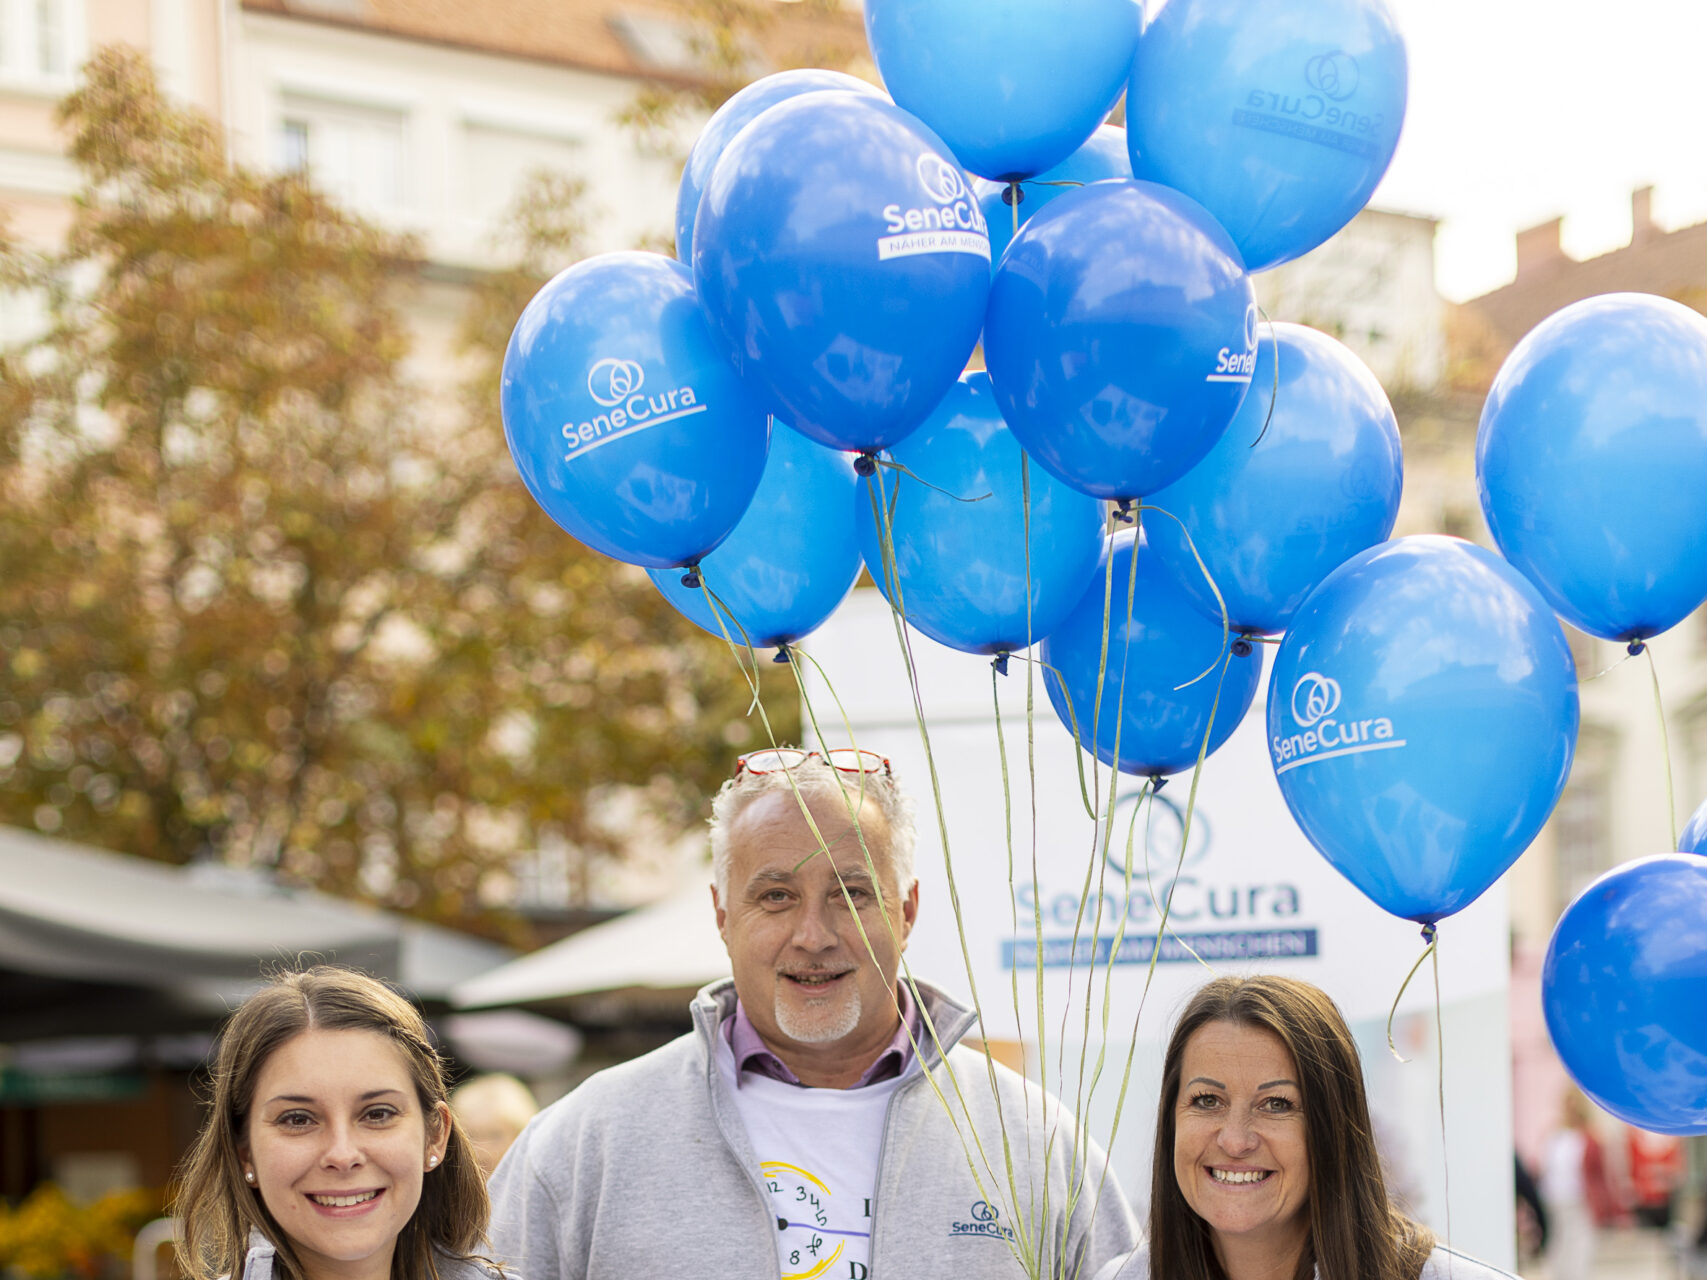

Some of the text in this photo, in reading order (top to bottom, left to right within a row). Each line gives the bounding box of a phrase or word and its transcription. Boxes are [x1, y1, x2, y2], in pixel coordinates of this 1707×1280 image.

[561, 386, 697, 449] SeneCura
[1273, 717, 1394, 764] SeneCura
[1013, 876, 1301, 928] SeneCura
[796, 1185, 807, 1201] 3
[810, 1193, 820, 1211] 4
[815, 1209, 828, 1227] 5
[952, 1221, 1013, 1238] SeneCura
[789, 1249, 801, 1265] 8
